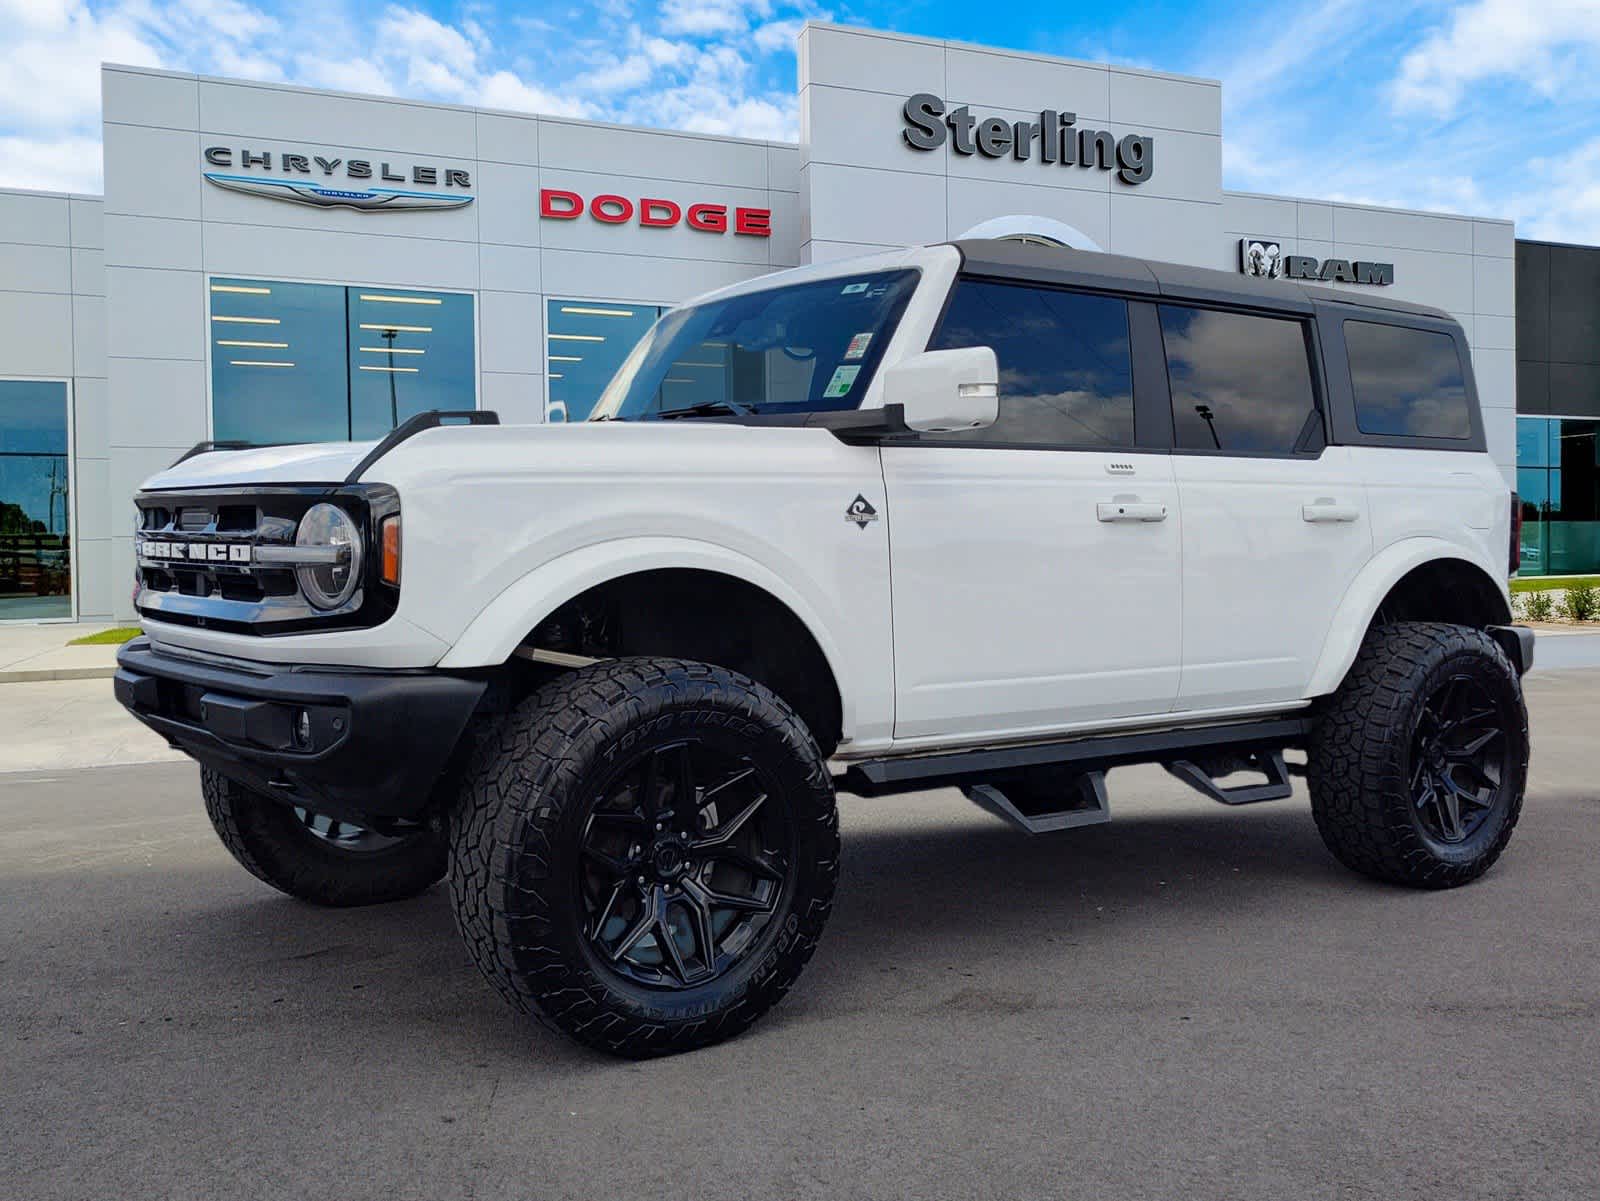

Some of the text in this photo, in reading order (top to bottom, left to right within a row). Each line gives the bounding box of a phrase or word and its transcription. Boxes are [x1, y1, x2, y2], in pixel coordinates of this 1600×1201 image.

[903, 93, 1154, 184] Sterling
[204, 147, 471, 187] CHRYSLER
[540, 188, 771, 237] DODGE
[1285, 255, 1394, 286] RAM
